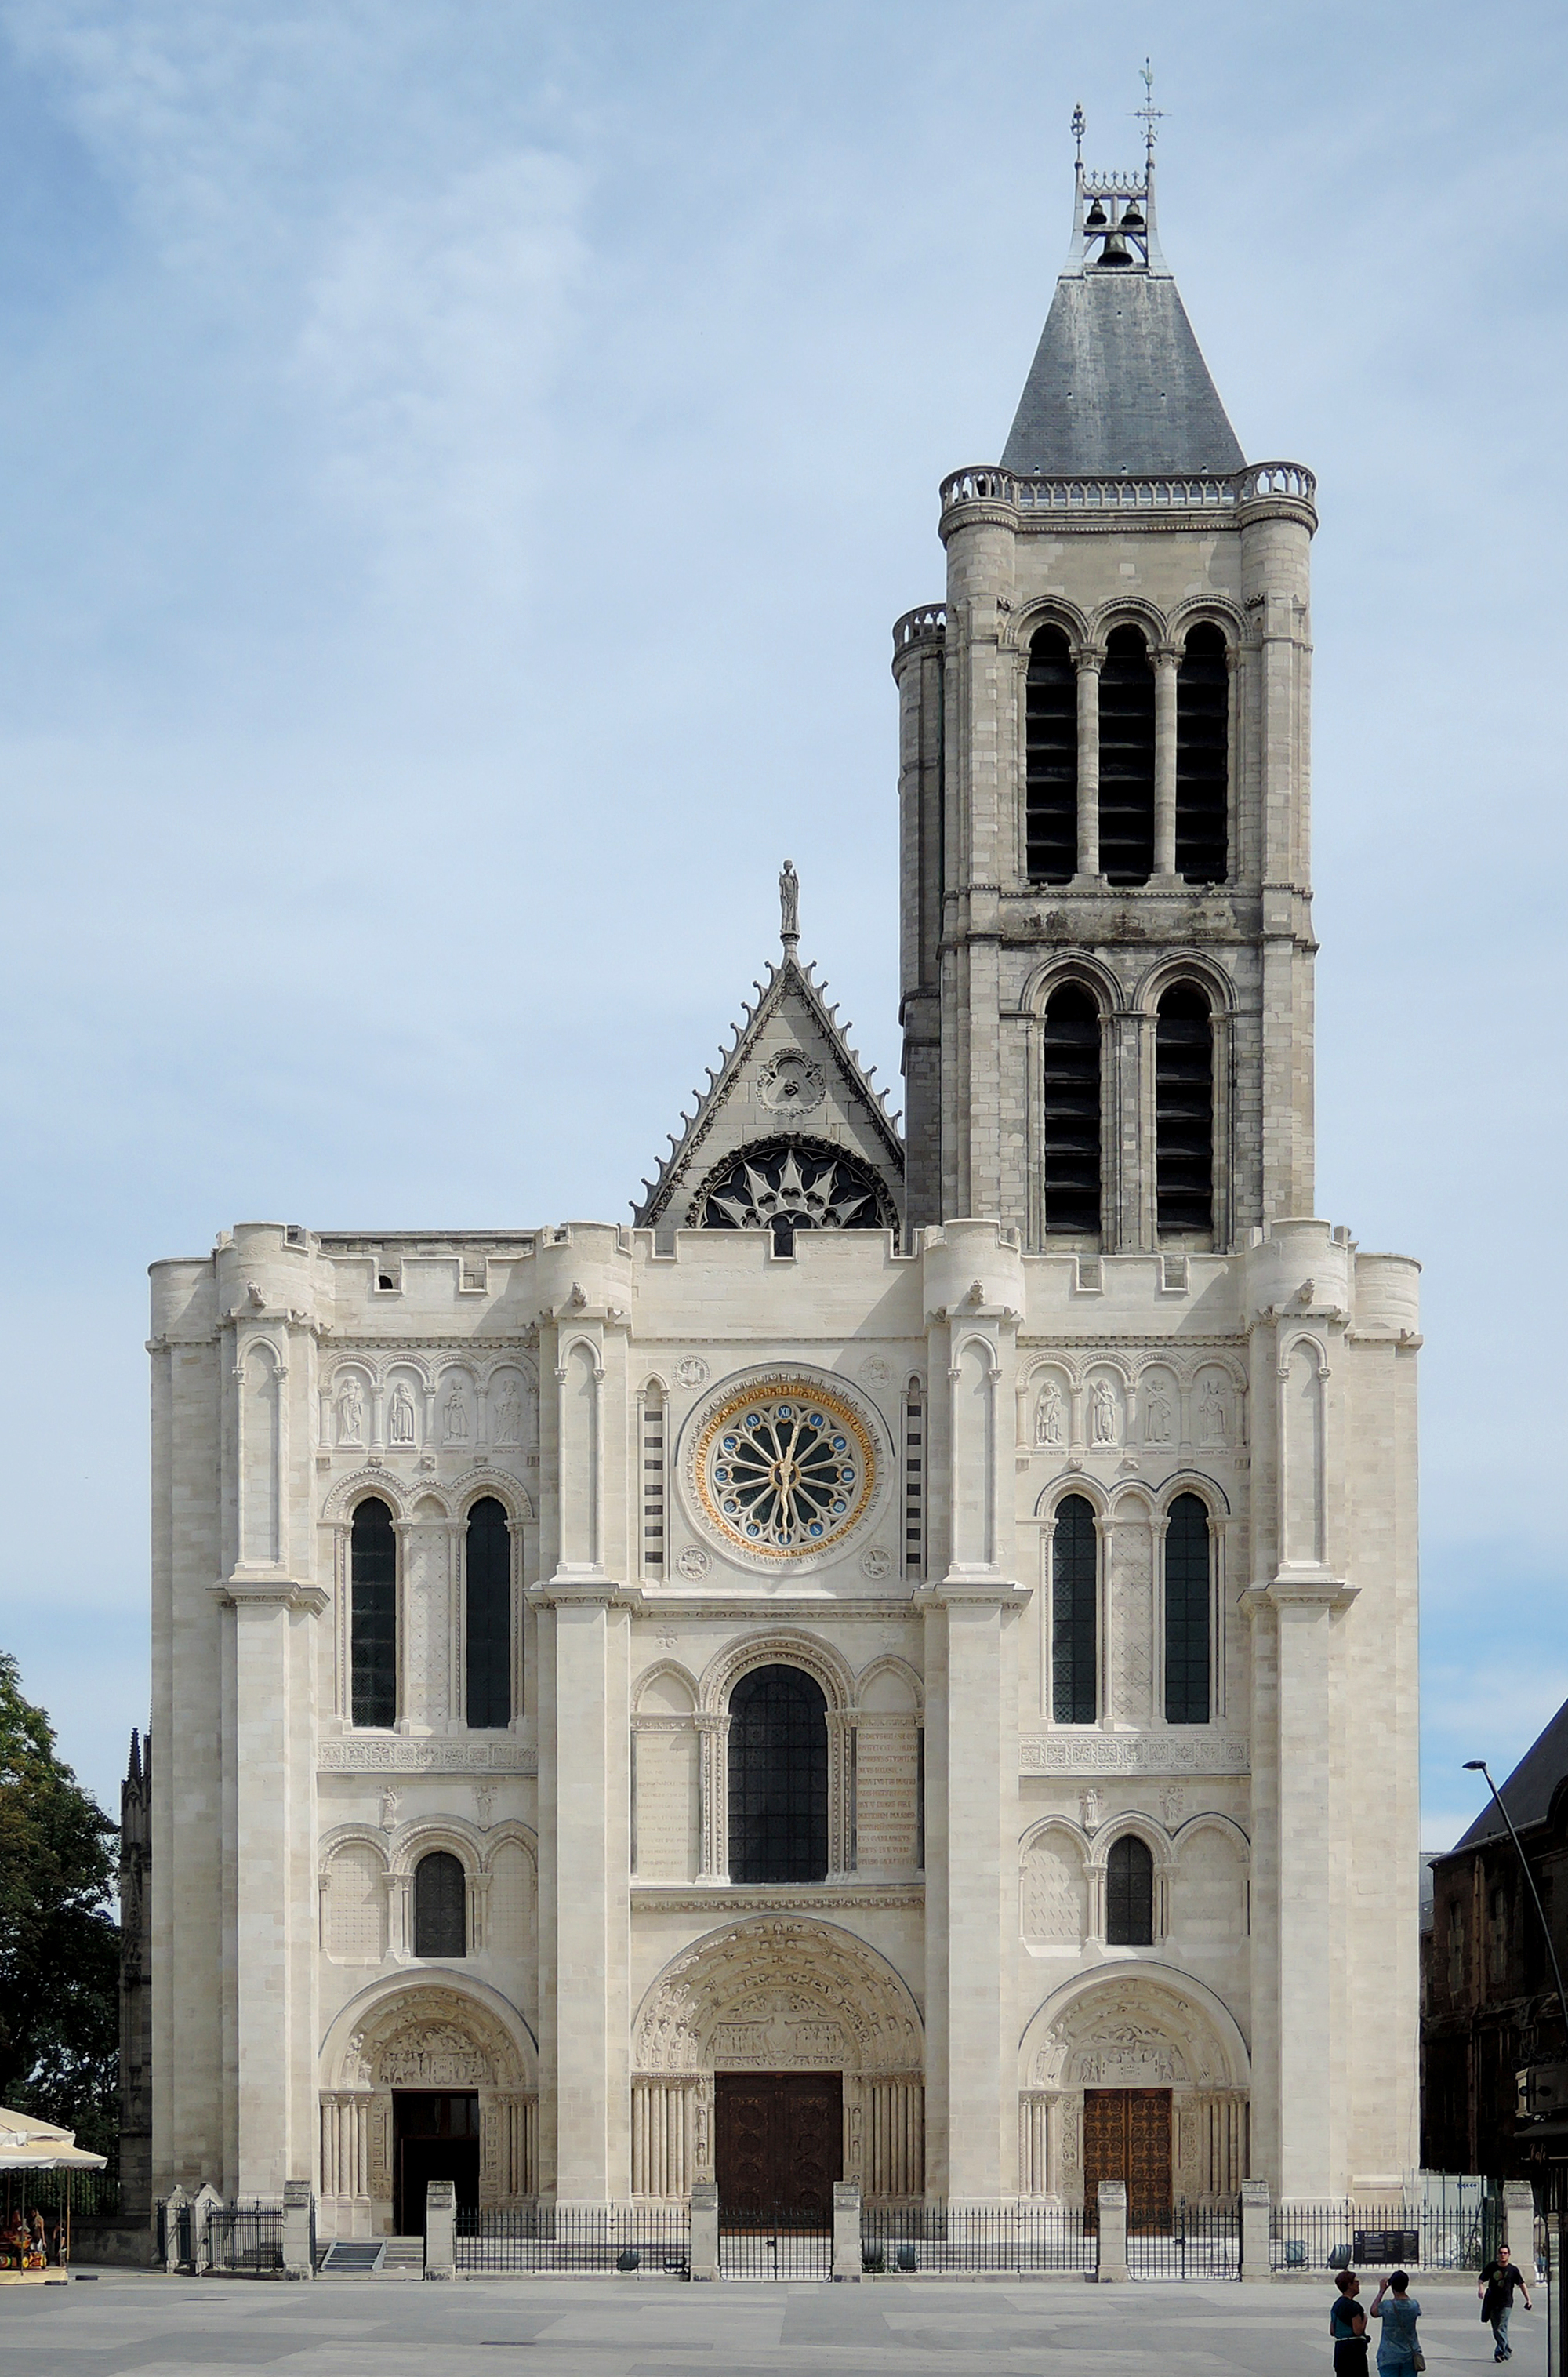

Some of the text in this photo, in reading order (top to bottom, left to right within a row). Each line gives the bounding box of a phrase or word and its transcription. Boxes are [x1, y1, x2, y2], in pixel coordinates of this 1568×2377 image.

[780, 1407, 790, 1417] XII
[748, 1415, 758, 1426] XI
[724, 1439, 734, 1448] X
[717, 1470, 727, 1479] IX
[747, 1525, 758, 1536] VII
[813, 1526, 821, 1535] V
